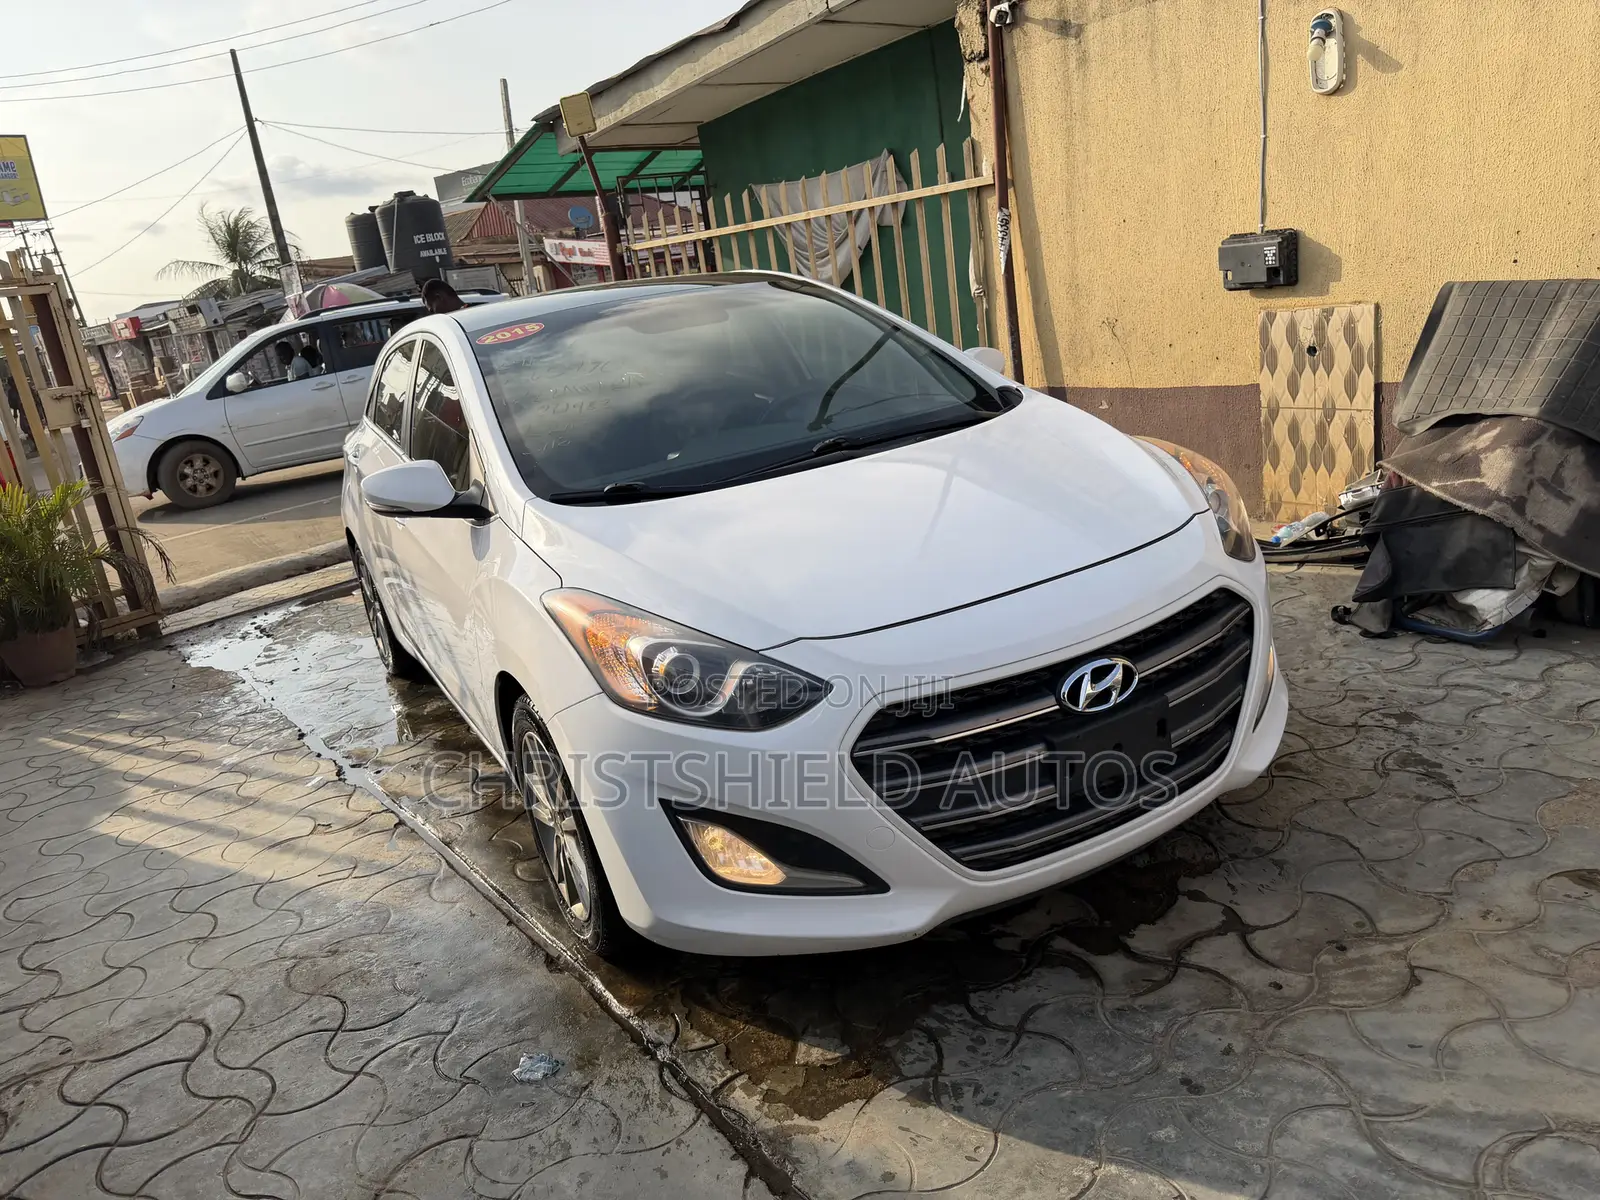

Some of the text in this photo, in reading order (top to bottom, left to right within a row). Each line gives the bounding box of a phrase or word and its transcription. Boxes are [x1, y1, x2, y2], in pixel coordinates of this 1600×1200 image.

[413, 232, 446, 244] ICE BLOCK
[420, 248, 447, 257] AVAILABLE
[484, 323, 540, 344] 2015
